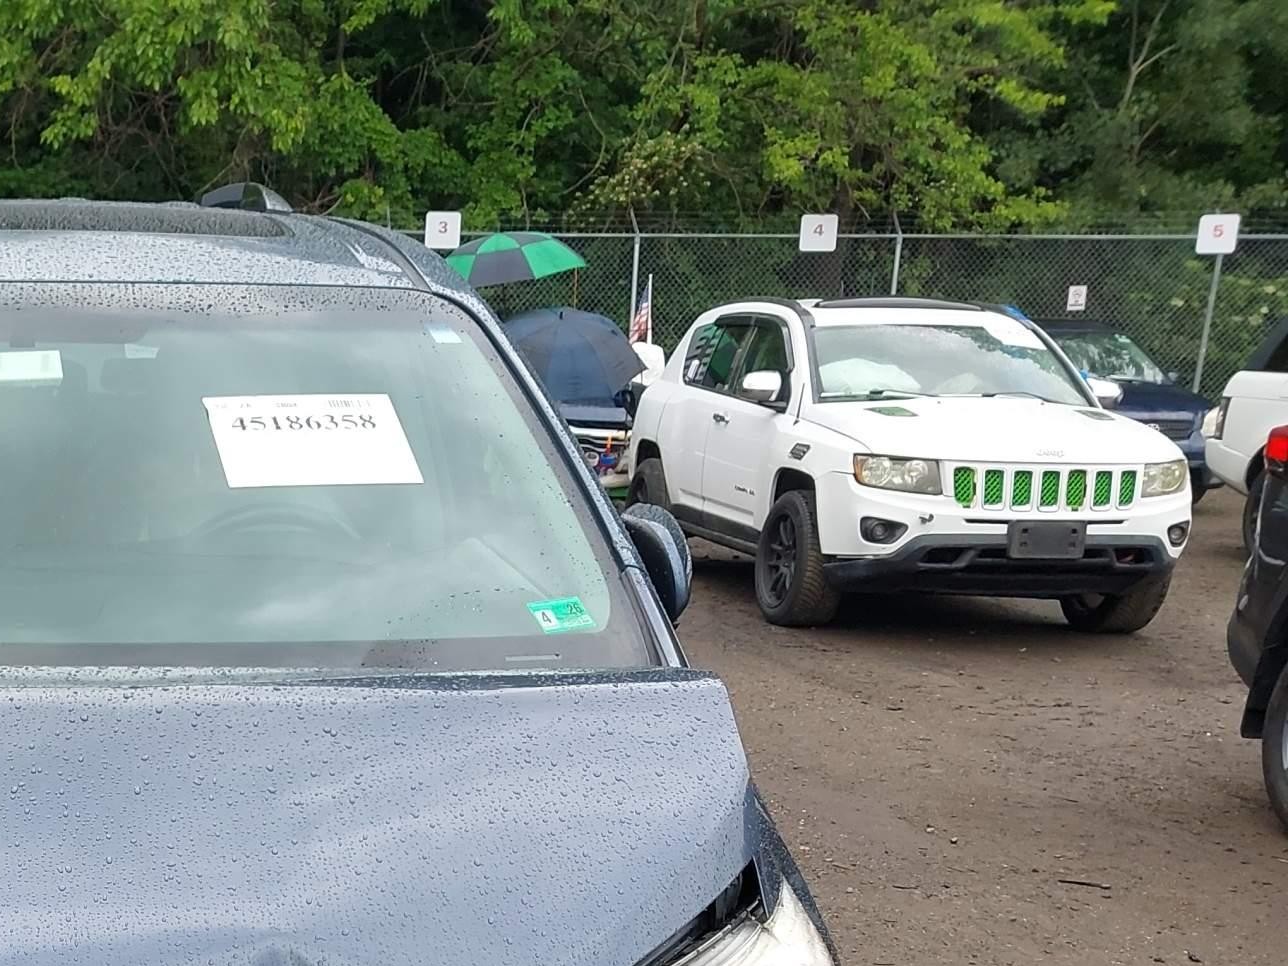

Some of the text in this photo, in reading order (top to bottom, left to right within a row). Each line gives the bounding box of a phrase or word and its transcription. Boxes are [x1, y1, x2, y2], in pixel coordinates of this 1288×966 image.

[438, 221, 448, 234] 3
[813, 223, 824, 236] 4
[1213, 224, 1224, 238] 5
[232, 414, 377, 431] 45186358
[541, 611, 552, 624] 4
